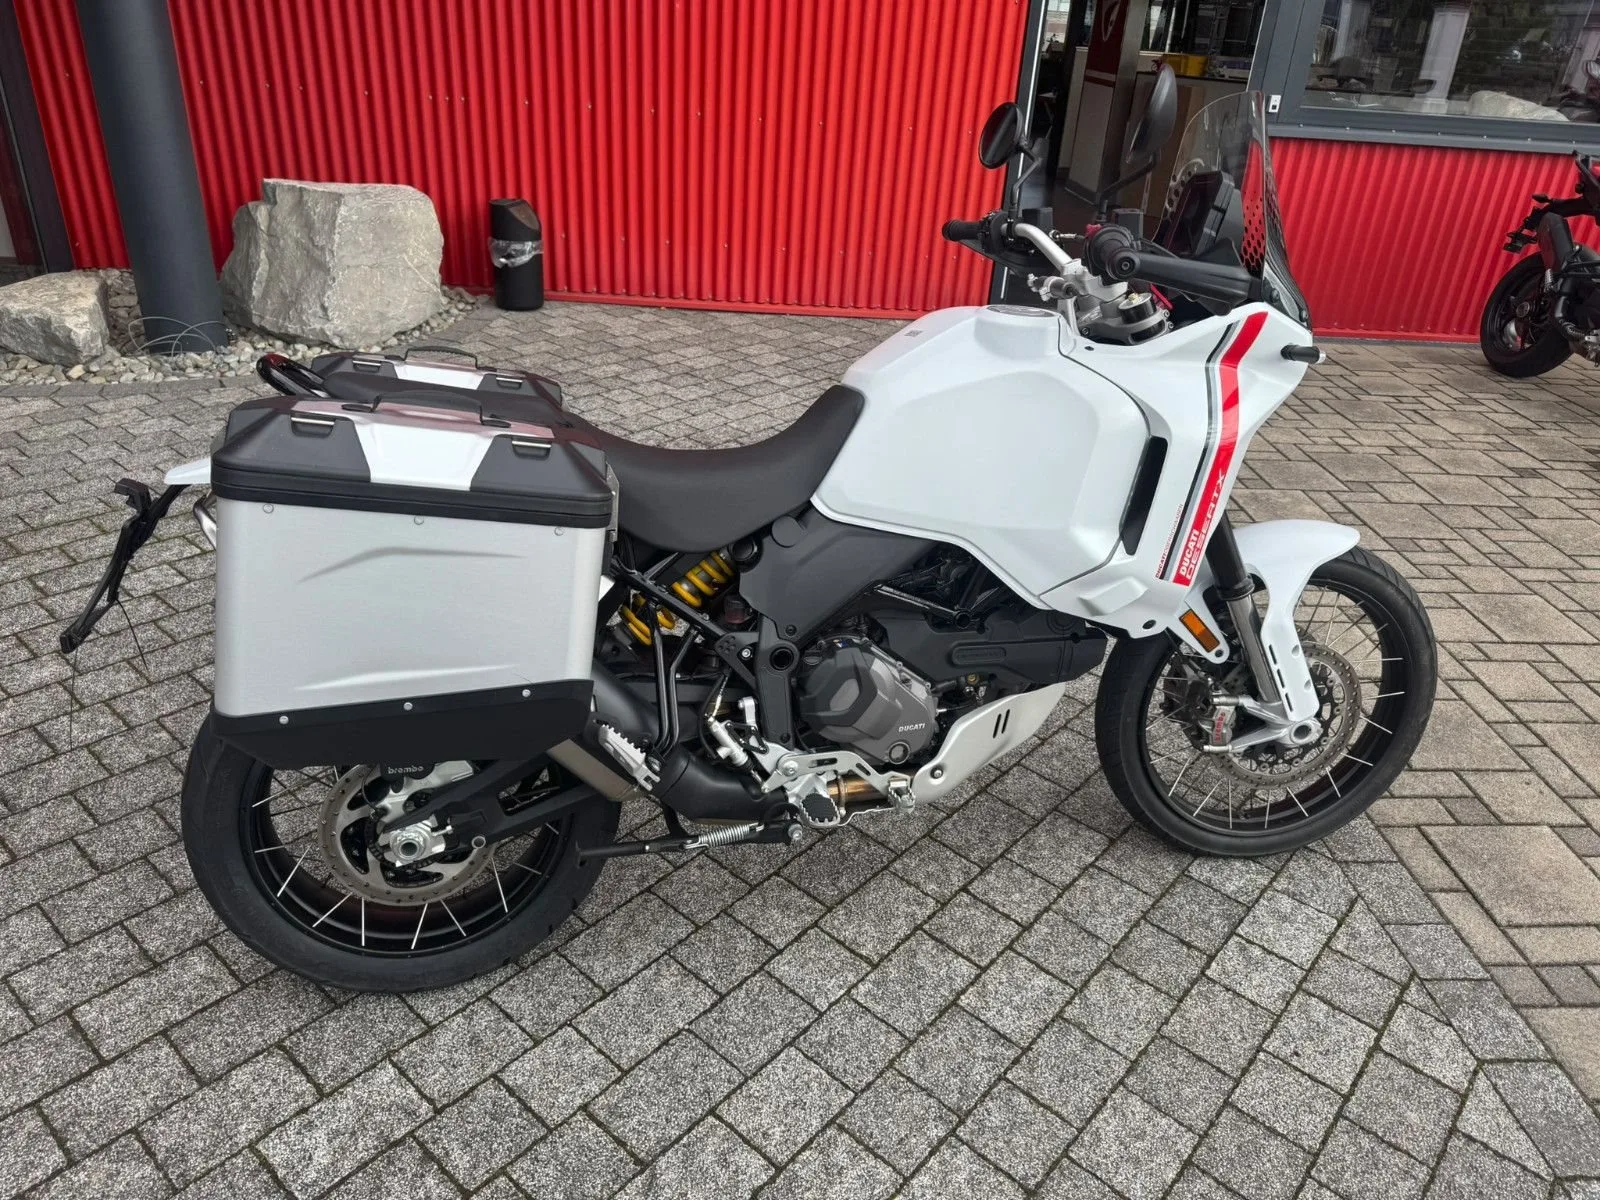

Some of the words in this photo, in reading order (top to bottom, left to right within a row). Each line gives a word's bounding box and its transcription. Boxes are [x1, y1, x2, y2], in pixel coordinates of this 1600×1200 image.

[1186, 468, 1225, 581] DESERTX
[1179, 528, 1200, 575] DUCATI
[898, 722, 926, 733] DUCATI
[387, 765, 424, 775] brembo
